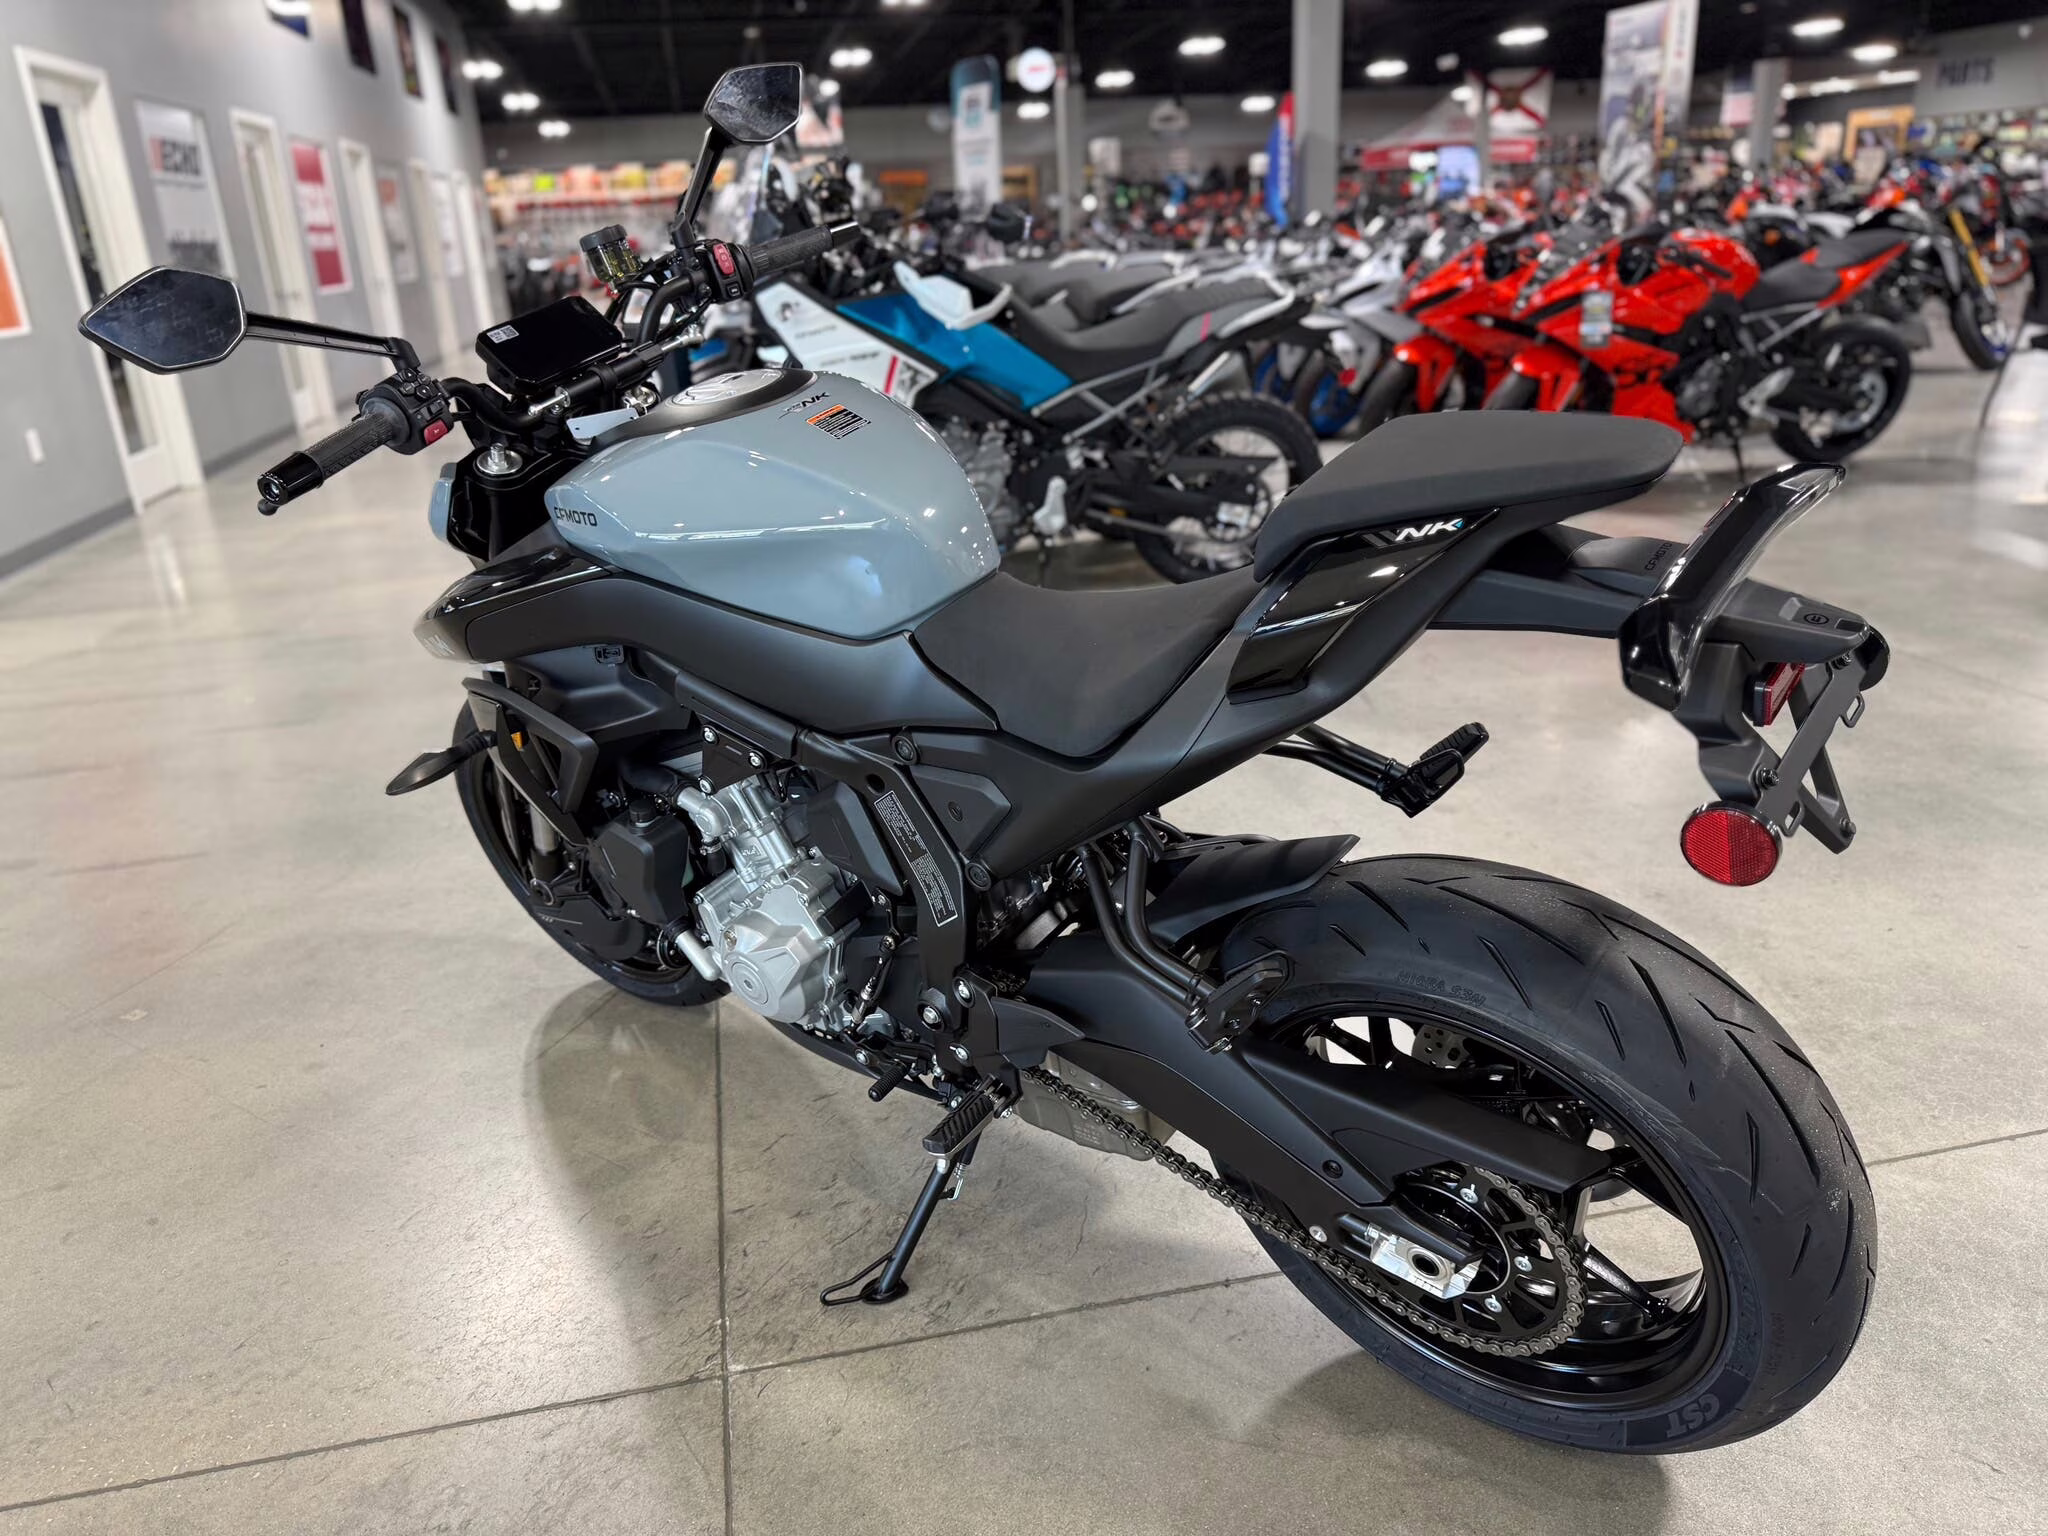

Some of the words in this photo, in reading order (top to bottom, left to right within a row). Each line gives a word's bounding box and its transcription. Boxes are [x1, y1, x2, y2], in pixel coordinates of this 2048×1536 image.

[553, 506, 598, 527] CFMOTO
[1394, 517, 1464, 542] NK
[1665, 1392, 1720, 1439] CST
